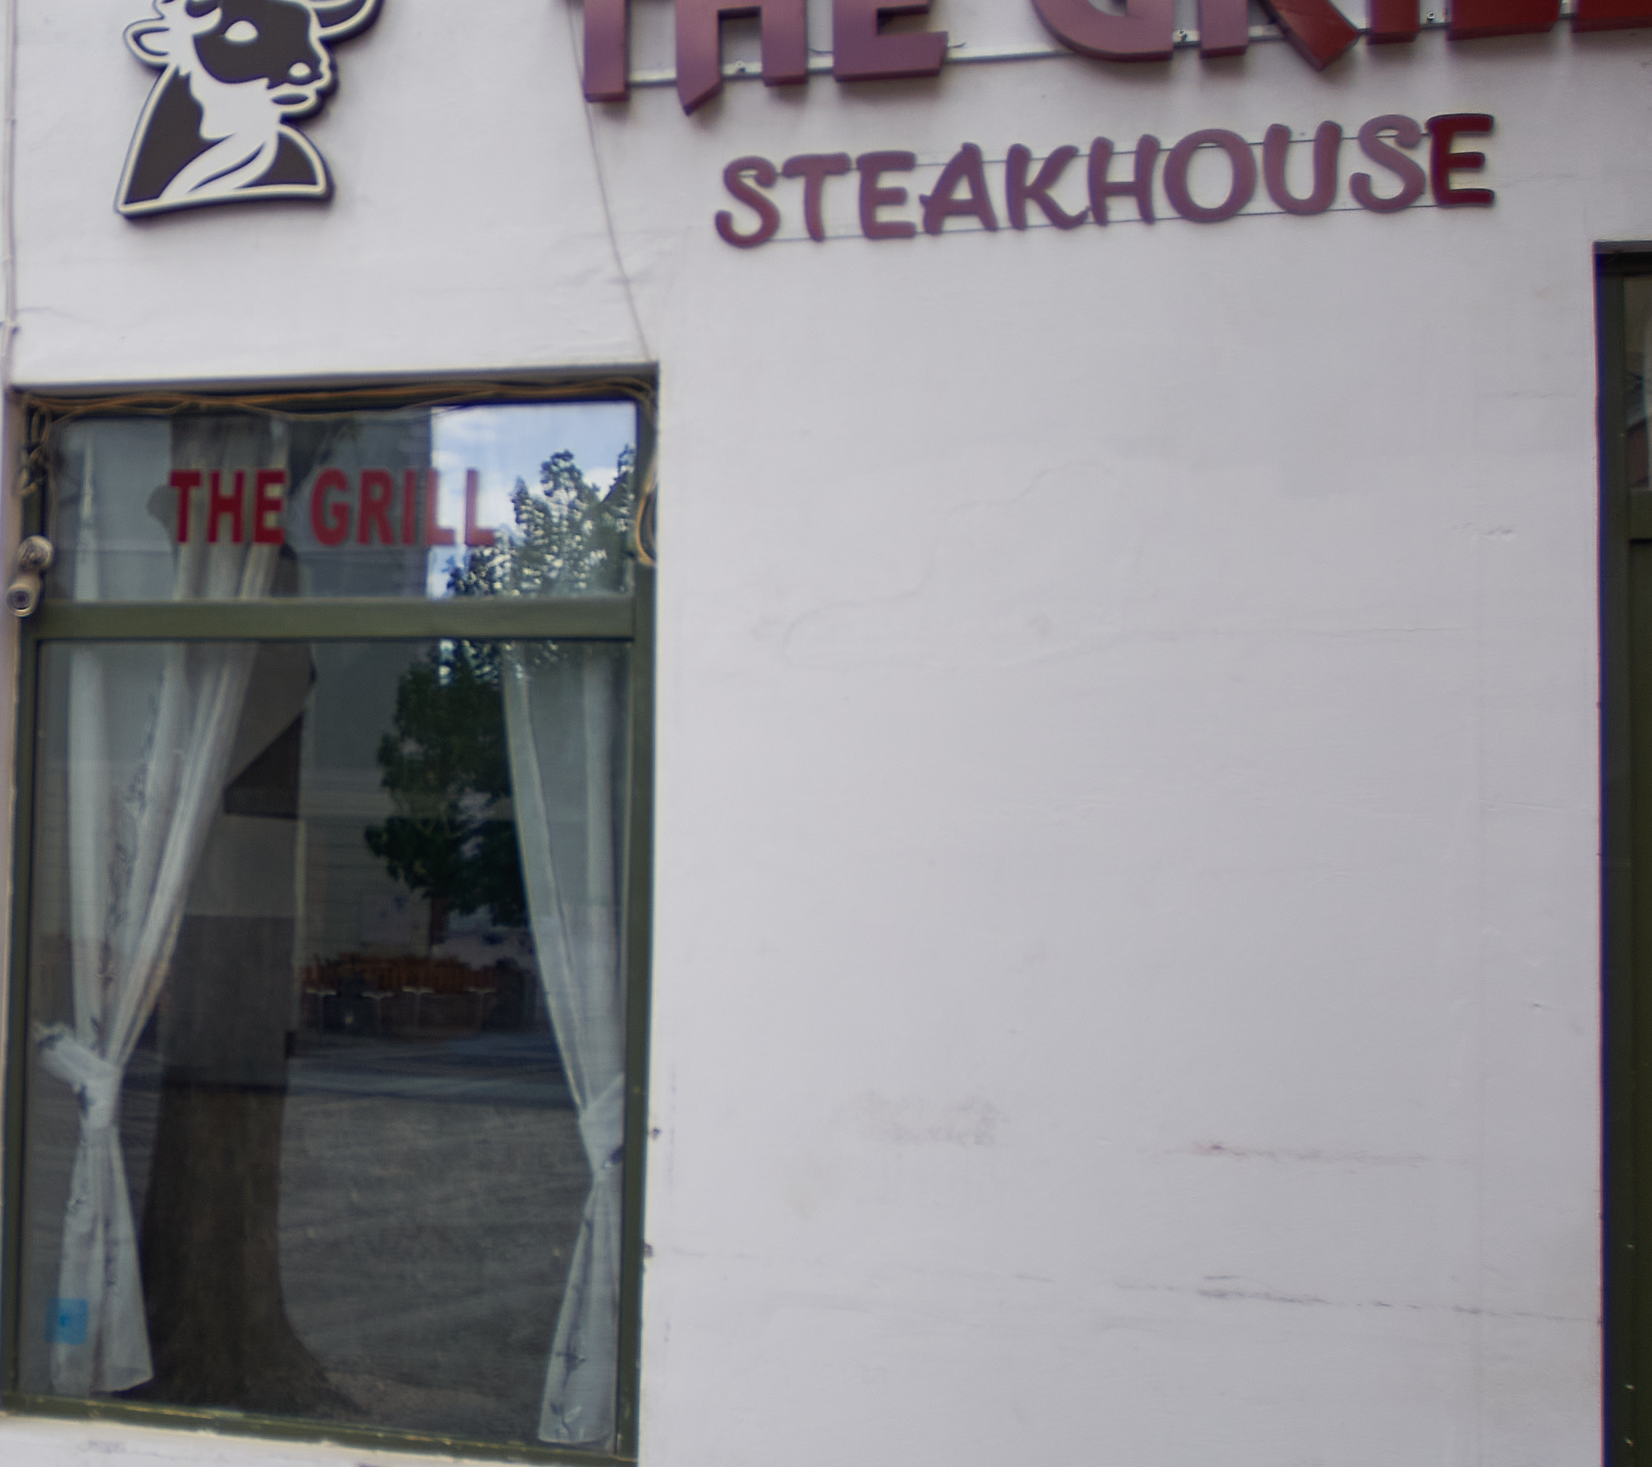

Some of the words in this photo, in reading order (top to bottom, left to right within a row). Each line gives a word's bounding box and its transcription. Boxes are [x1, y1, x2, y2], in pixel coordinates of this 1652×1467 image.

[714, 113, 1496, 248] STEAKHOUSE
[169, 470, 286, 545] THE
[309, 468, 496, 547] GRILL
